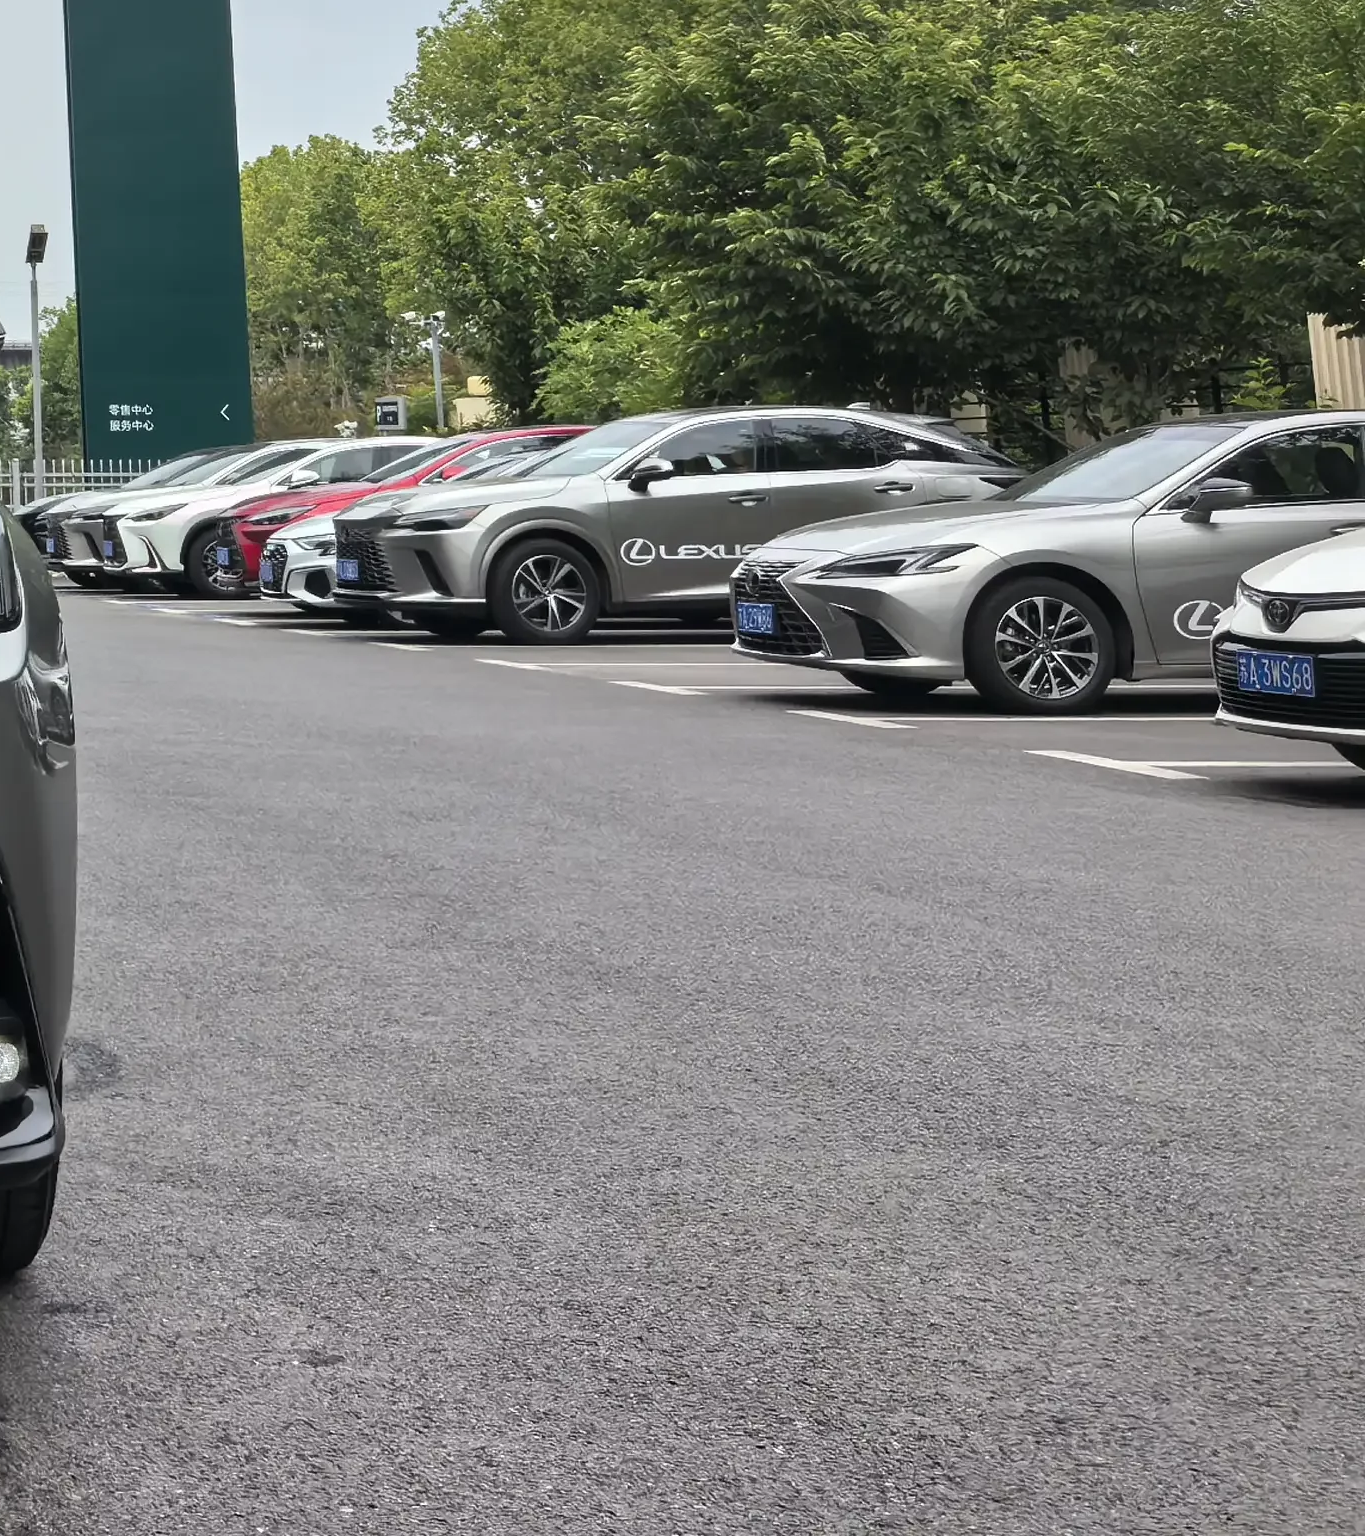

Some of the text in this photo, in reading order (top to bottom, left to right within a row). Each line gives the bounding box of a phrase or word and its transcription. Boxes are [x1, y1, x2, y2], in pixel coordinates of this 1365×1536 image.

[109, 404, 154, 416] 零售中心
[110, 419, 155, 431] 服务中心
